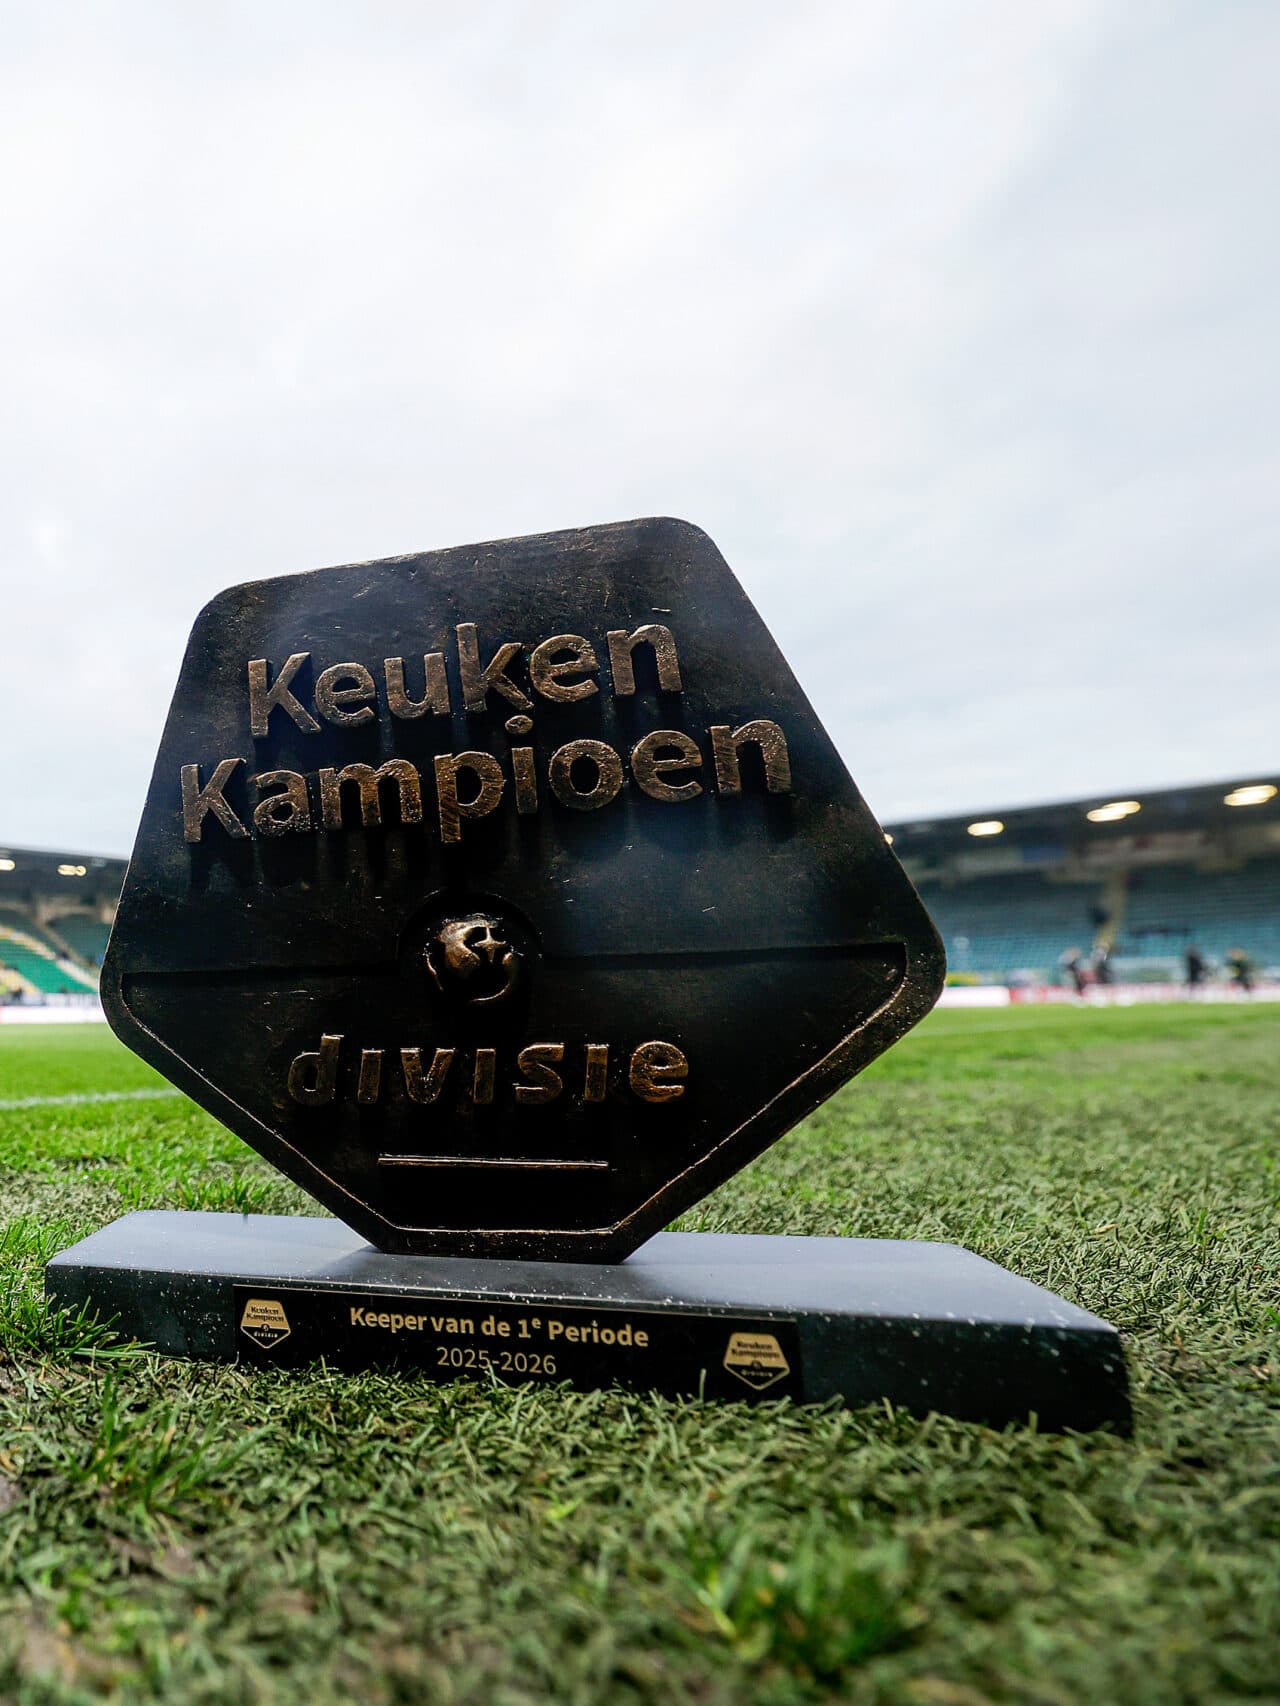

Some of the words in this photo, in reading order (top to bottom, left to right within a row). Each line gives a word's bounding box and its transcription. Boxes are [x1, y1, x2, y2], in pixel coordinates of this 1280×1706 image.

[247, 621, 684, 738] Keuken
[179, 714, 793, 843] Kampioen
[287, 1033, 690, 1104] divisie
[350, 1307, 426, 1333] Keeper
[431, 1315, 474, 1334] van
[481, 1316, 511, 1337] de
[548, 1320, 649, 1348] Periode
[436, 1347, 557, 1375] 2025-2026
